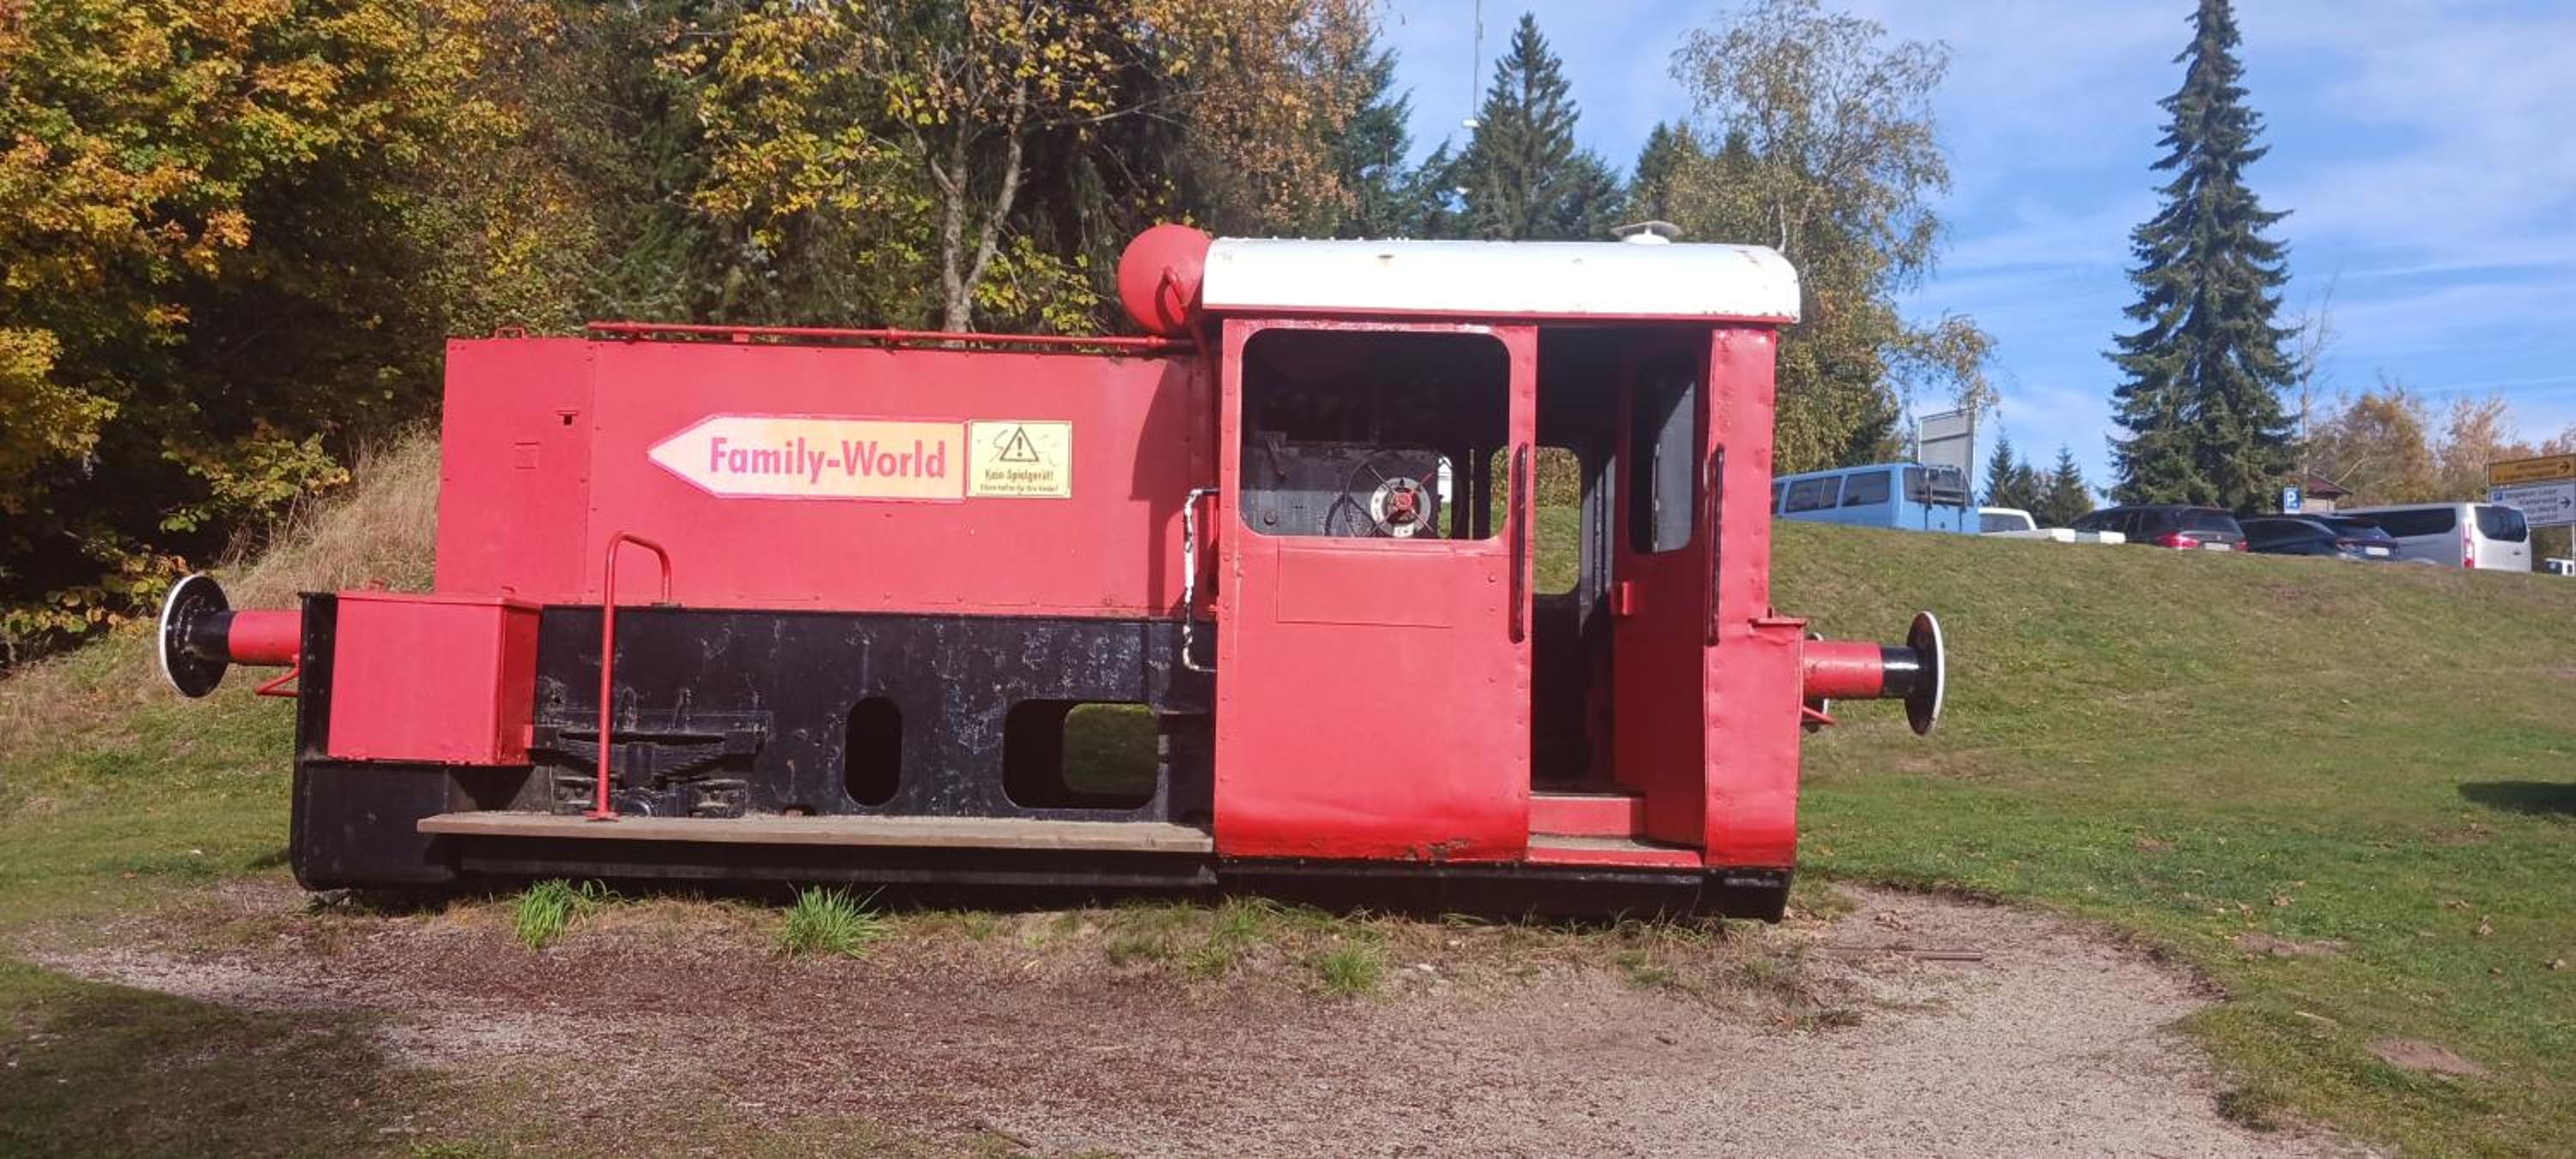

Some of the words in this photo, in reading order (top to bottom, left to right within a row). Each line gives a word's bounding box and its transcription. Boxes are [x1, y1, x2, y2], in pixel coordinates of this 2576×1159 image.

[710, 437, 945, 484] Family-World
[985, 469, 1005, 481] Kein
[2287, 491, 2296, 507] P
